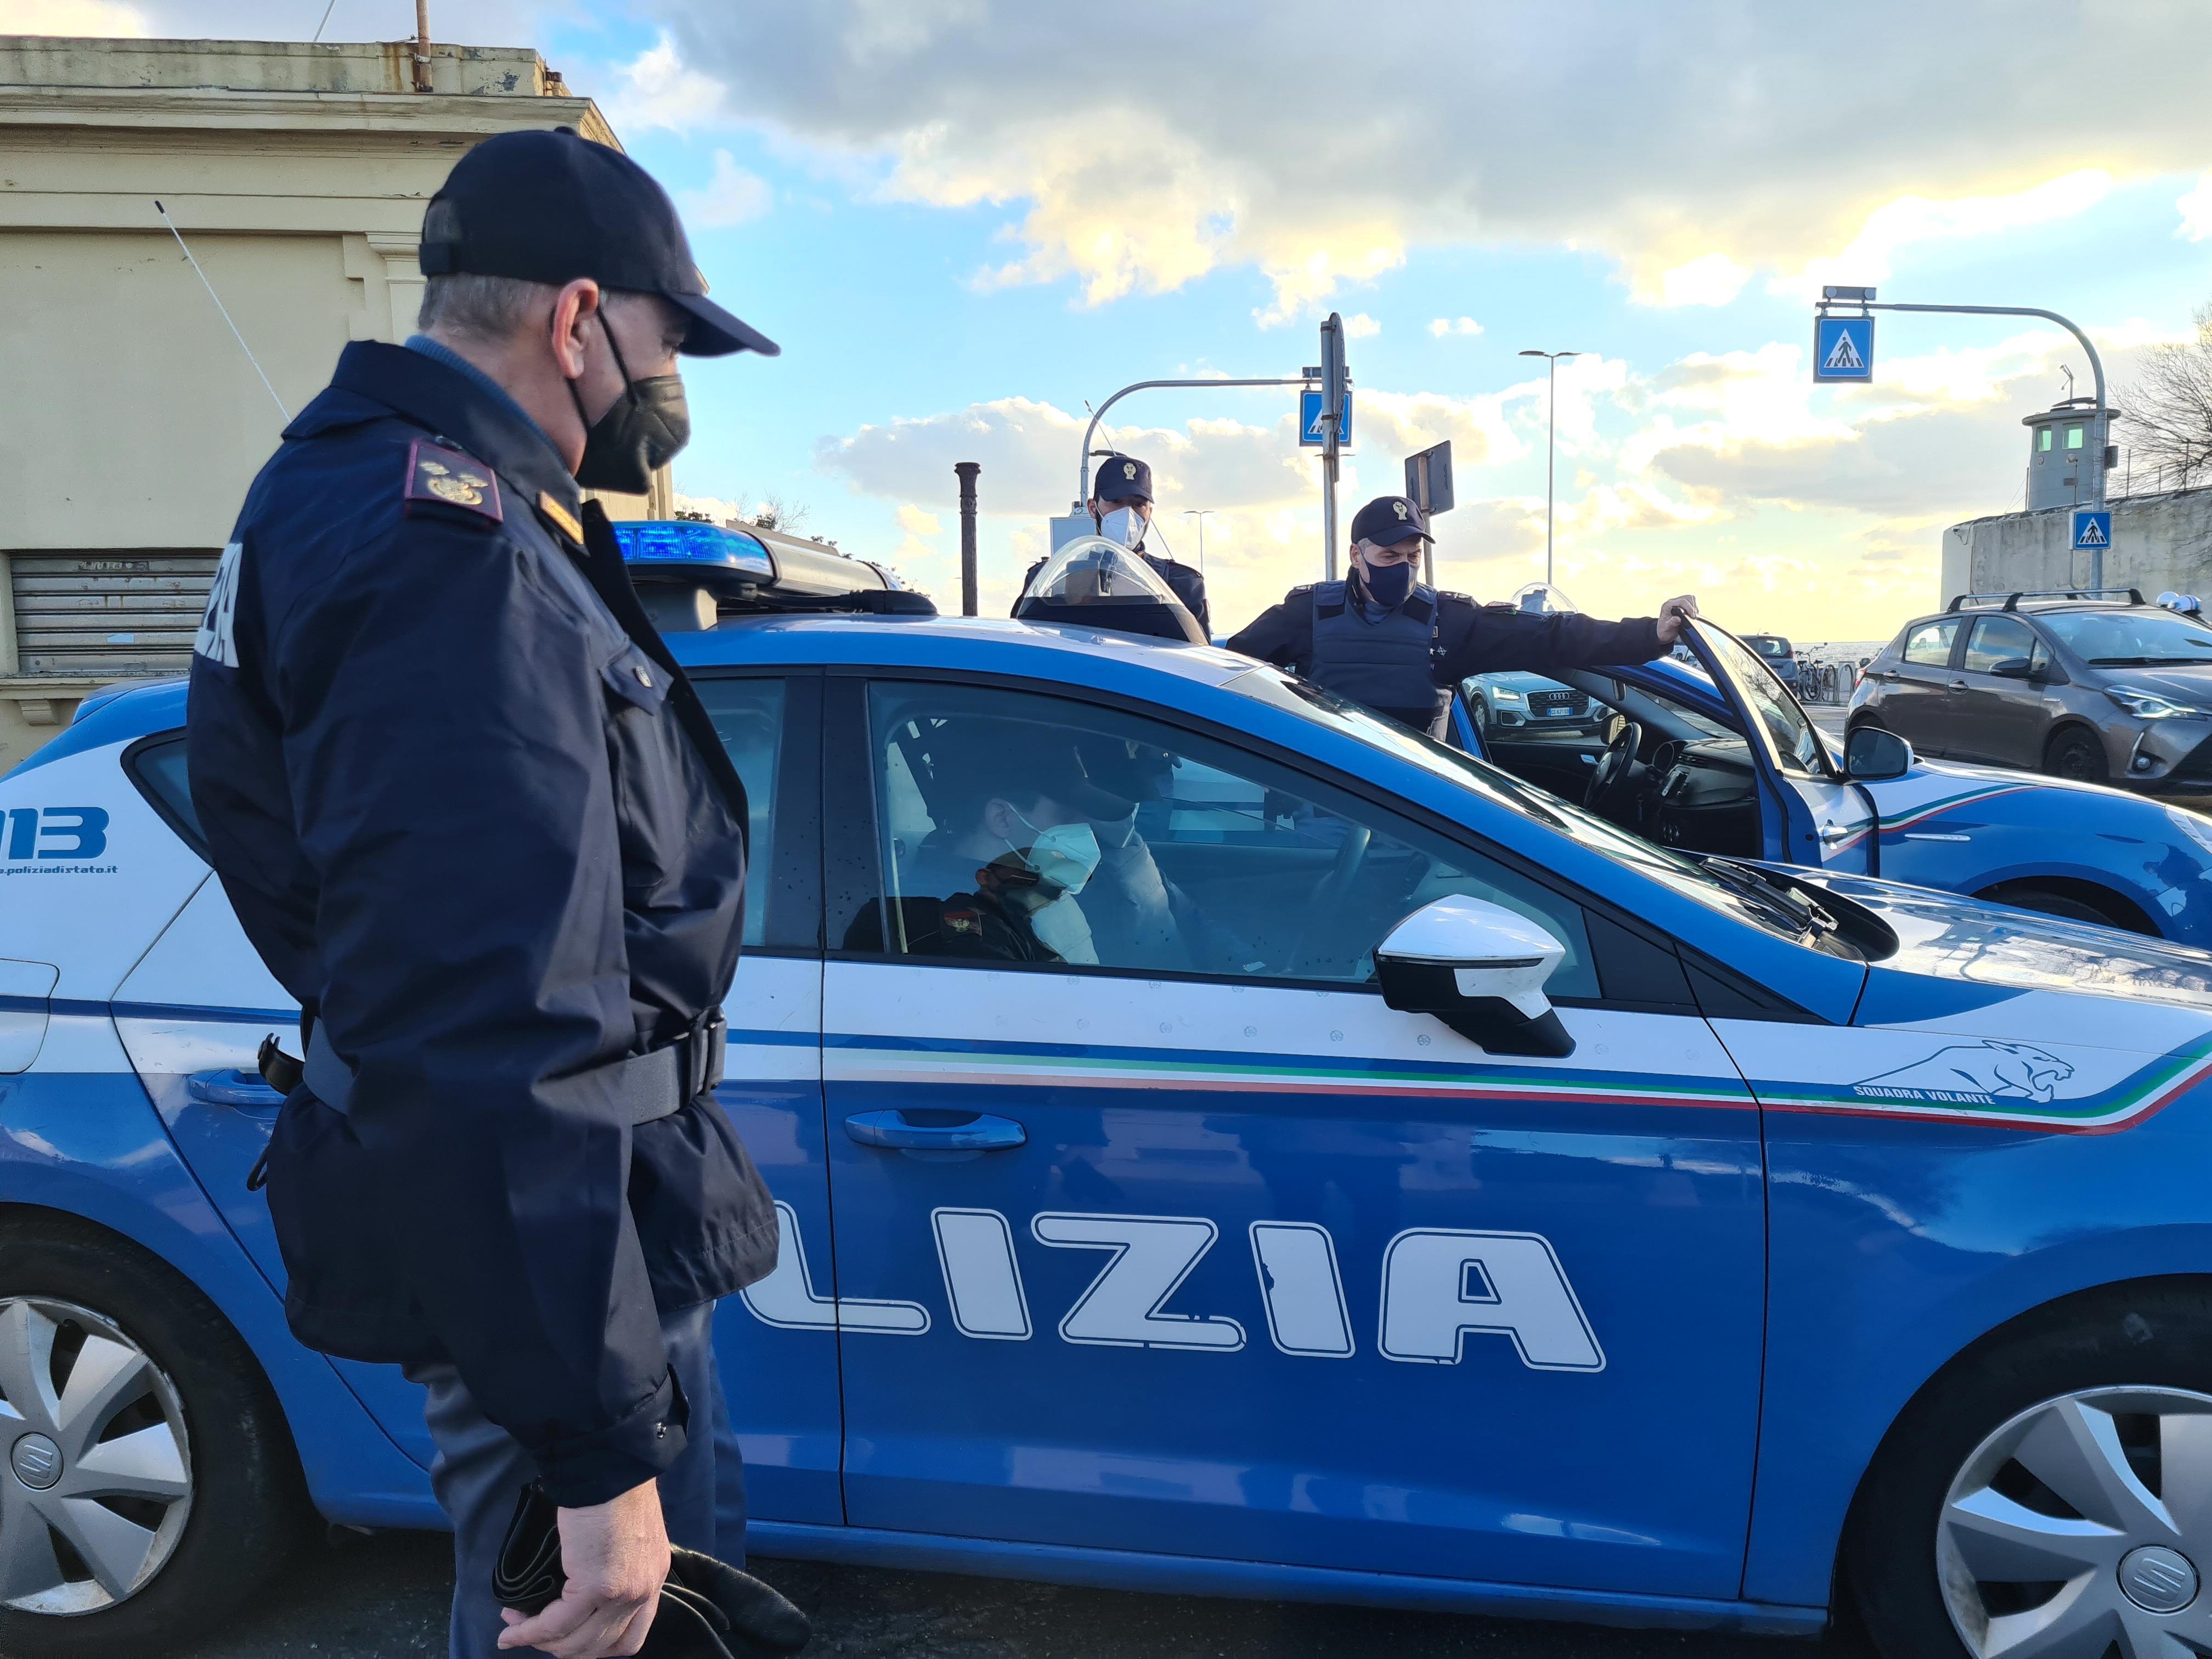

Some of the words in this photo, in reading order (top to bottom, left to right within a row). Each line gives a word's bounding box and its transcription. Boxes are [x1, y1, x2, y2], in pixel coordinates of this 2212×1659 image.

[0, 806, 110, 860] 13
[1853, 1086, 1925, 1100] SQUADRA
[1925, 1090, 1996, 1105] VOLANTE
[713, 1200, 1606, 1373] LIZIA
